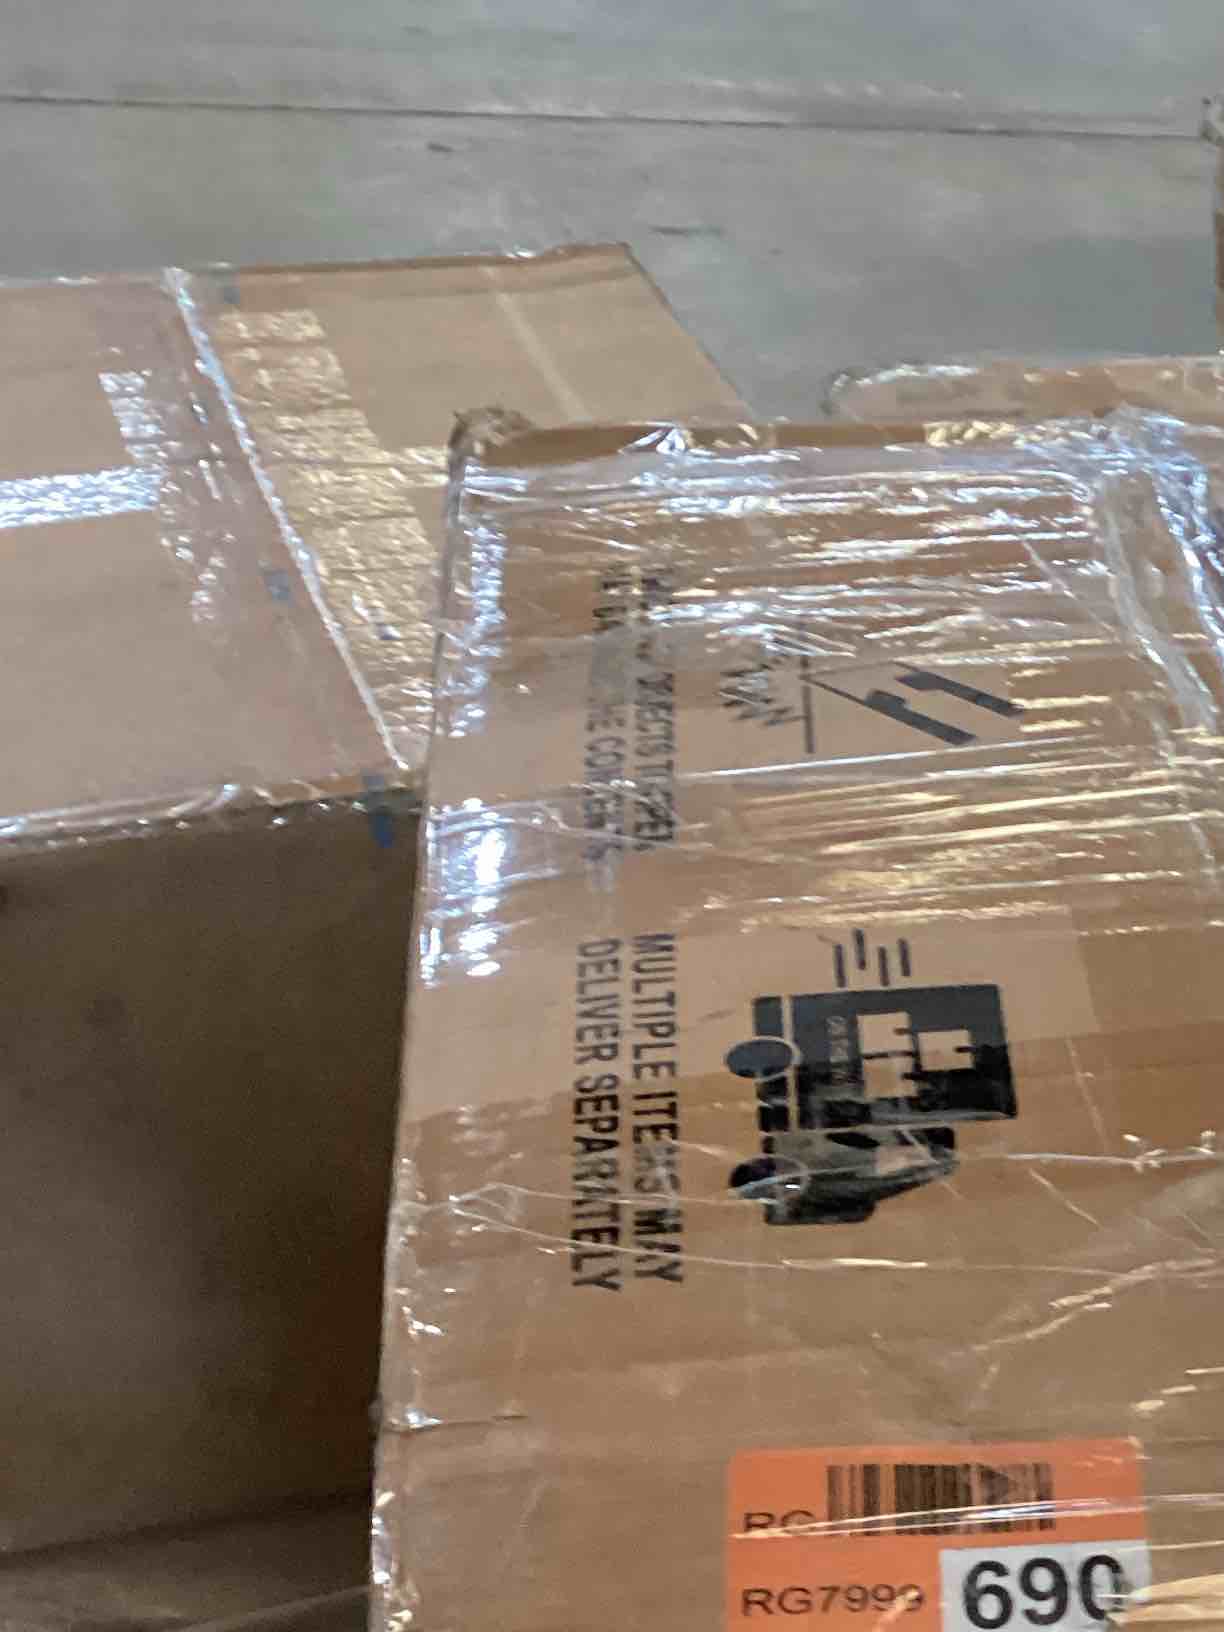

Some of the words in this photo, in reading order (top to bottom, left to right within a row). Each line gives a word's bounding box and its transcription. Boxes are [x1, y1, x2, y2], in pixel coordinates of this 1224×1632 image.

[574, 938, 622, 1066] DELIVER
[631, 933, 677, 1080] MULTIPLE
[569, 1074, 622, 1292] SEPARATELY
[632, 1090, 682, 1198] ITEMS
[634, 1208, 684, 1284] MAY
[962, 1553, 1130, 1630] 690
